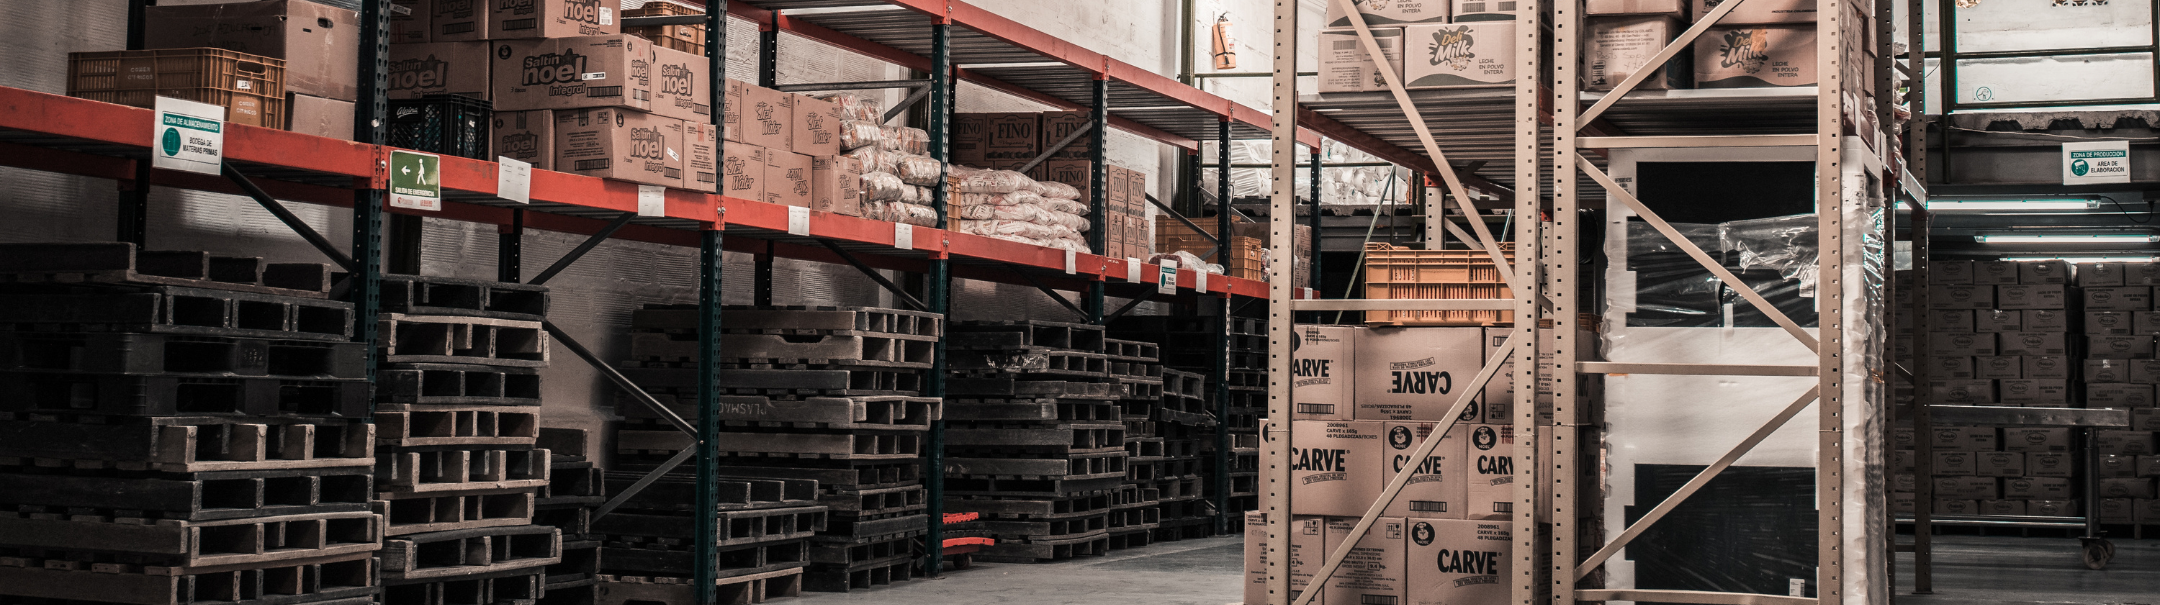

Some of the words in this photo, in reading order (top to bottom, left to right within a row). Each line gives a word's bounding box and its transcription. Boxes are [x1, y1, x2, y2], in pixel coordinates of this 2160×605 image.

[564, 0, 600, 24] noel
[1442, 30, 1463, 46] Deli
[1434, 39, 1470, 62] Milk
[388, 62, 446, 88] noel
[523, 56, 584, 84] noel
[632, 64, 648, 78] noel
[549, 83, 586, 97] Integral
[662, 72, 693, 96] noel
[164, 116, 176, 124] ZONA
[957, 123, 980, 135] FINO
[997, 122, 1031, 139] FINO
[182, 144, 203, 154] MATERIAS
[203, 148, 218, 156] PRIMAS
[190, 136, 206, 145] BODEGA
[206, 139, 212, 147] DE
[502, 136, 538, 153] noel
[630, 134, 664, 160] noel
[1060, 170, 1083, 182] FINO
[1294, 359, 1329, 377] ARVE
[1392, 371, 1452, 394] CARVE
[1437, 549, 1497, 574] CARVE
